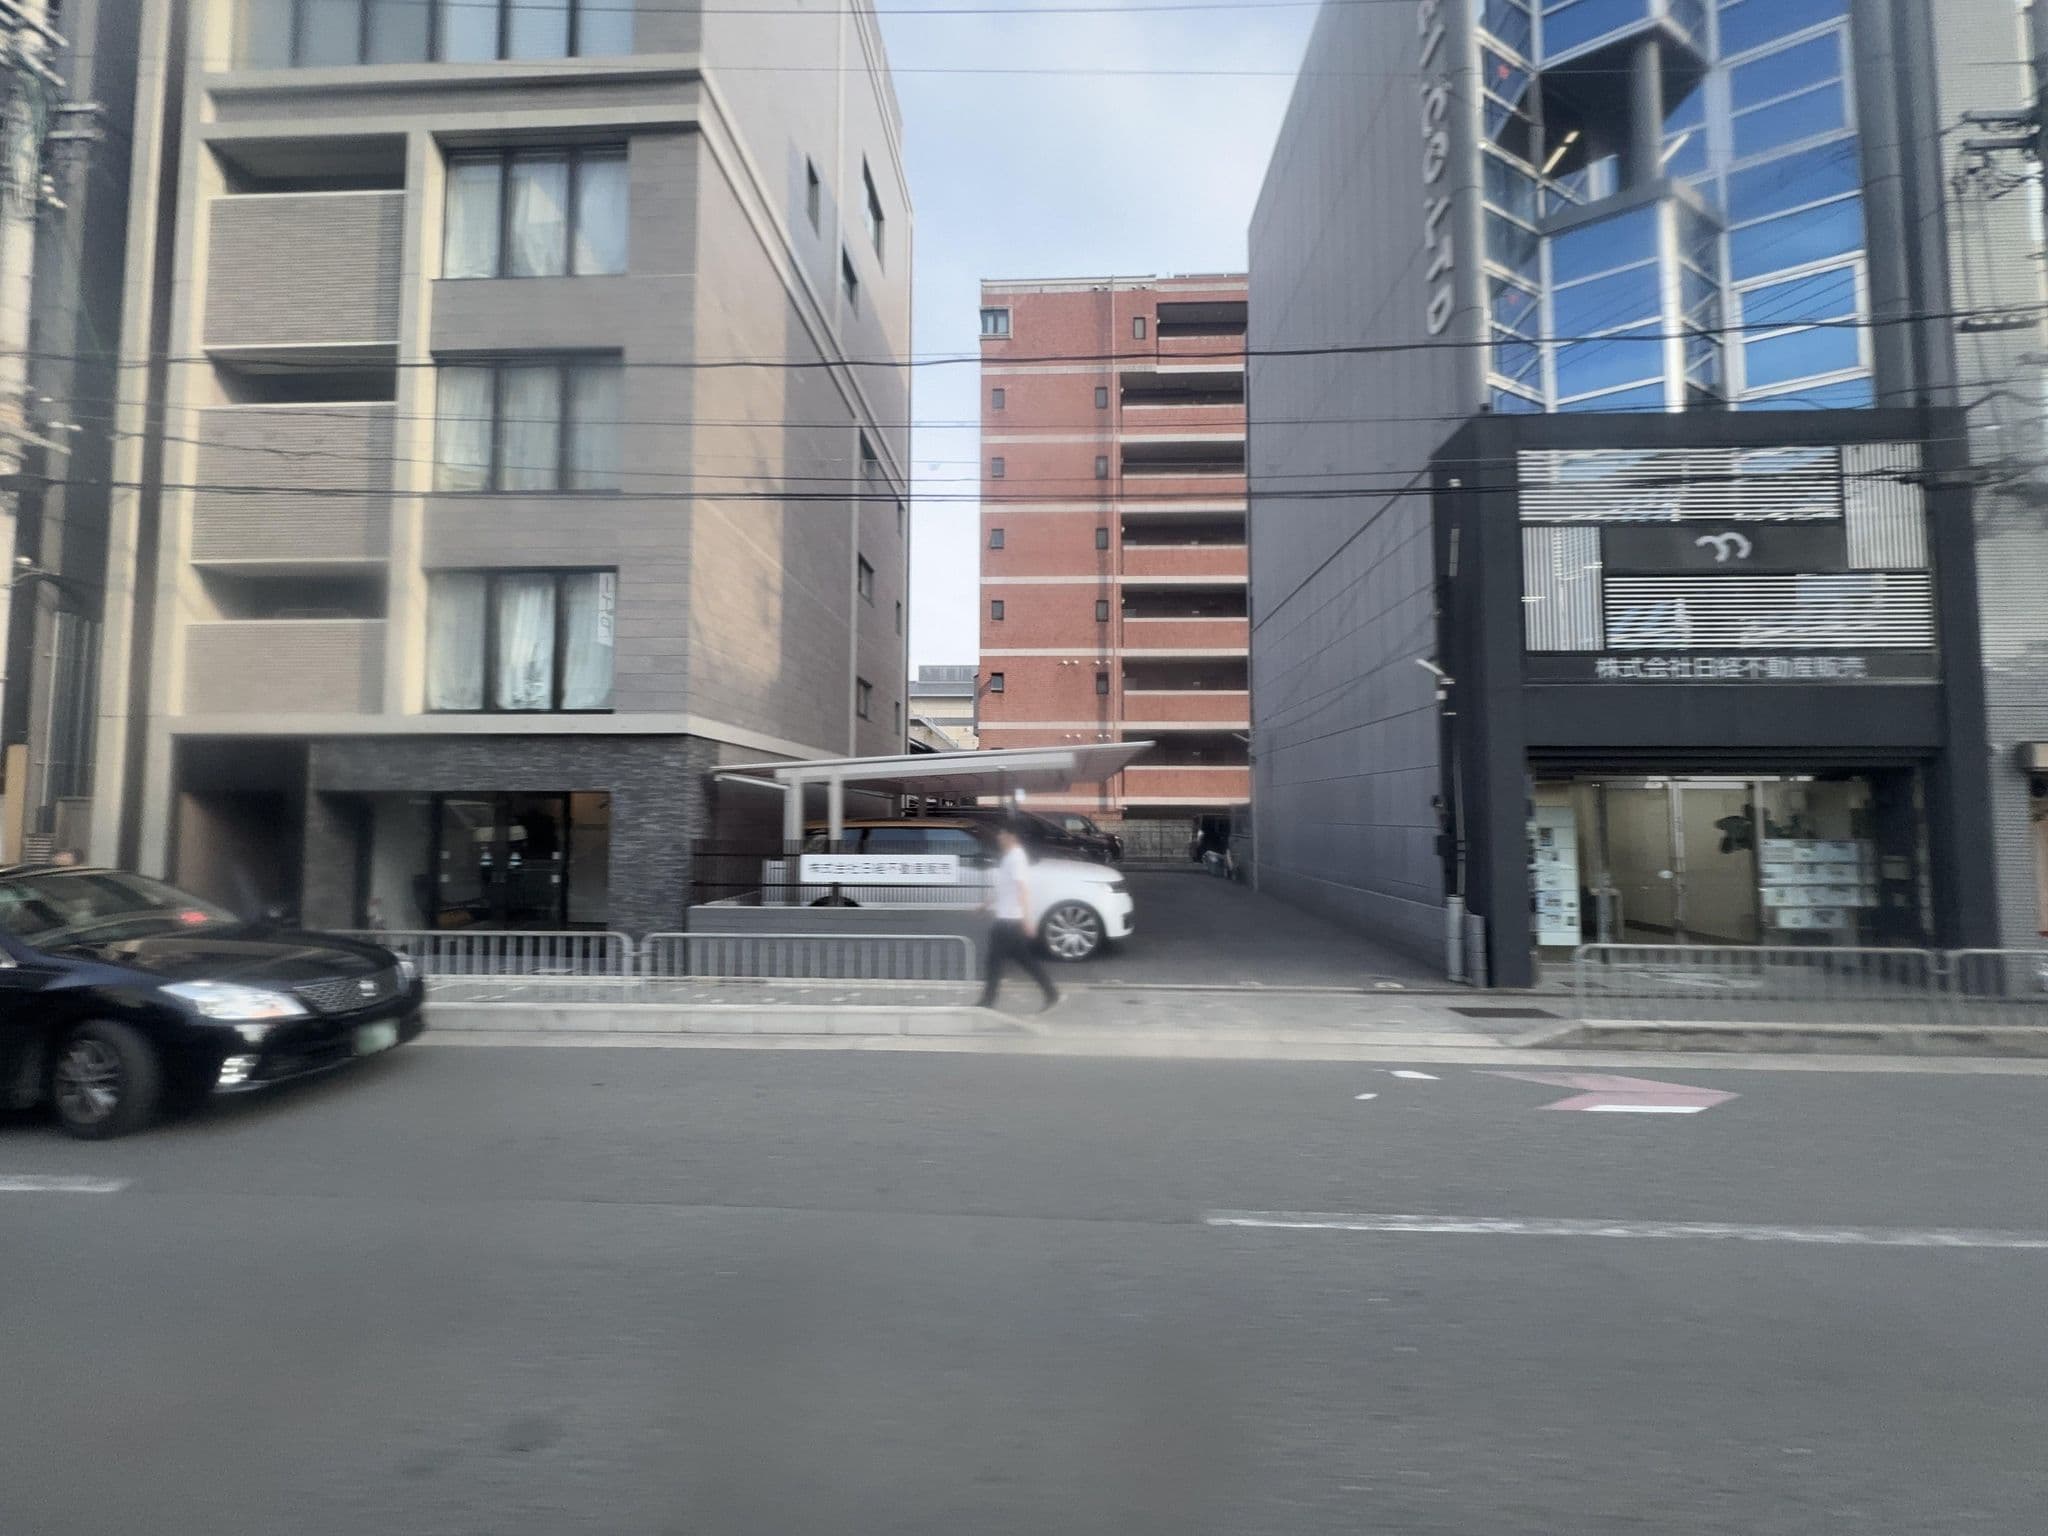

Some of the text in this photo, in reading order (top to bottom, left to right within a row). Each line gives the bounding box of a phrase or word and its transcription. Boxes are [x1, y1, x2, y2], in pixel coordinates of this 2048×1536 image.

[1595, 656, 1867, 678] 株式会社日経不動産販売
